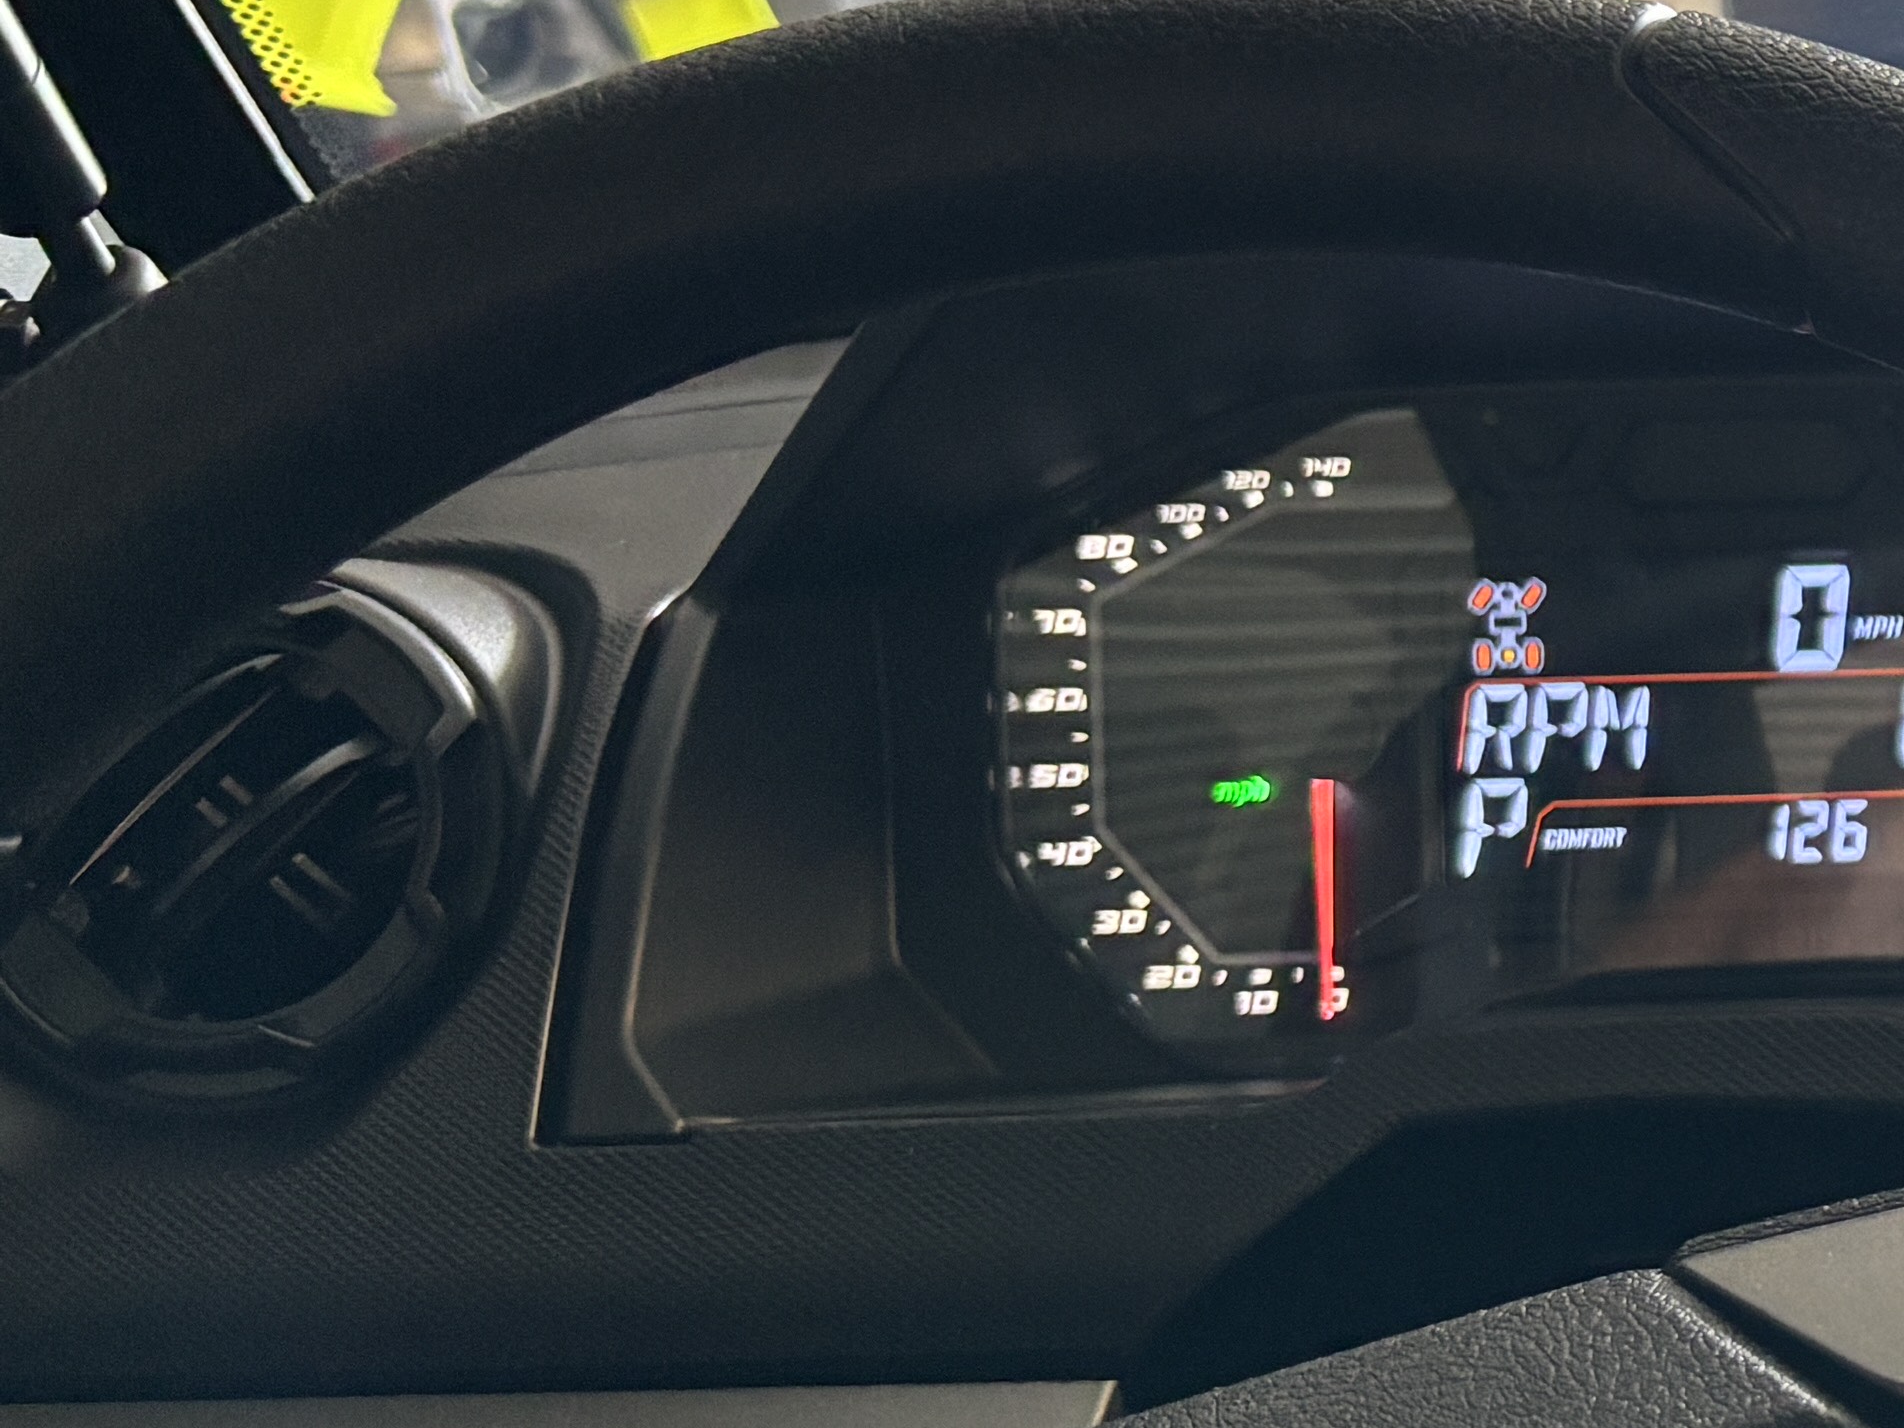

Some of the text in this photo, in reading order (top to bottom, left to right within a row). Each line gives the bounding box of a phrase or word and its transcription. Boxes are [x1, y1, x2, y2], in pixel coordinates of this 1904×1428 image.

[1301, 456, 1352, 477] 140
[1223, 470, 1271, 490] 120
[1156, 503, 1206, 523] 100
[1076, 534, 1135, 560] 80
[1033, 608, 1083, 635] 70
[1774, 563, 1904, 672] 0 MPH
[1025, 687, 1084, 713] 60
[1463, 681, 1651, 775] RPM
[1028, 762, 1086, 789] 50
[1212, 775, 1271, 807] mph
[1456, 776, 1869, 879] P COMFORT 126
[1037, 840, 1094, 866] 40
[1092, 909, 1148, 935] 30
[1142, 964, 1202, 990] 20
[1233, 990, 1279, 1015] 10
